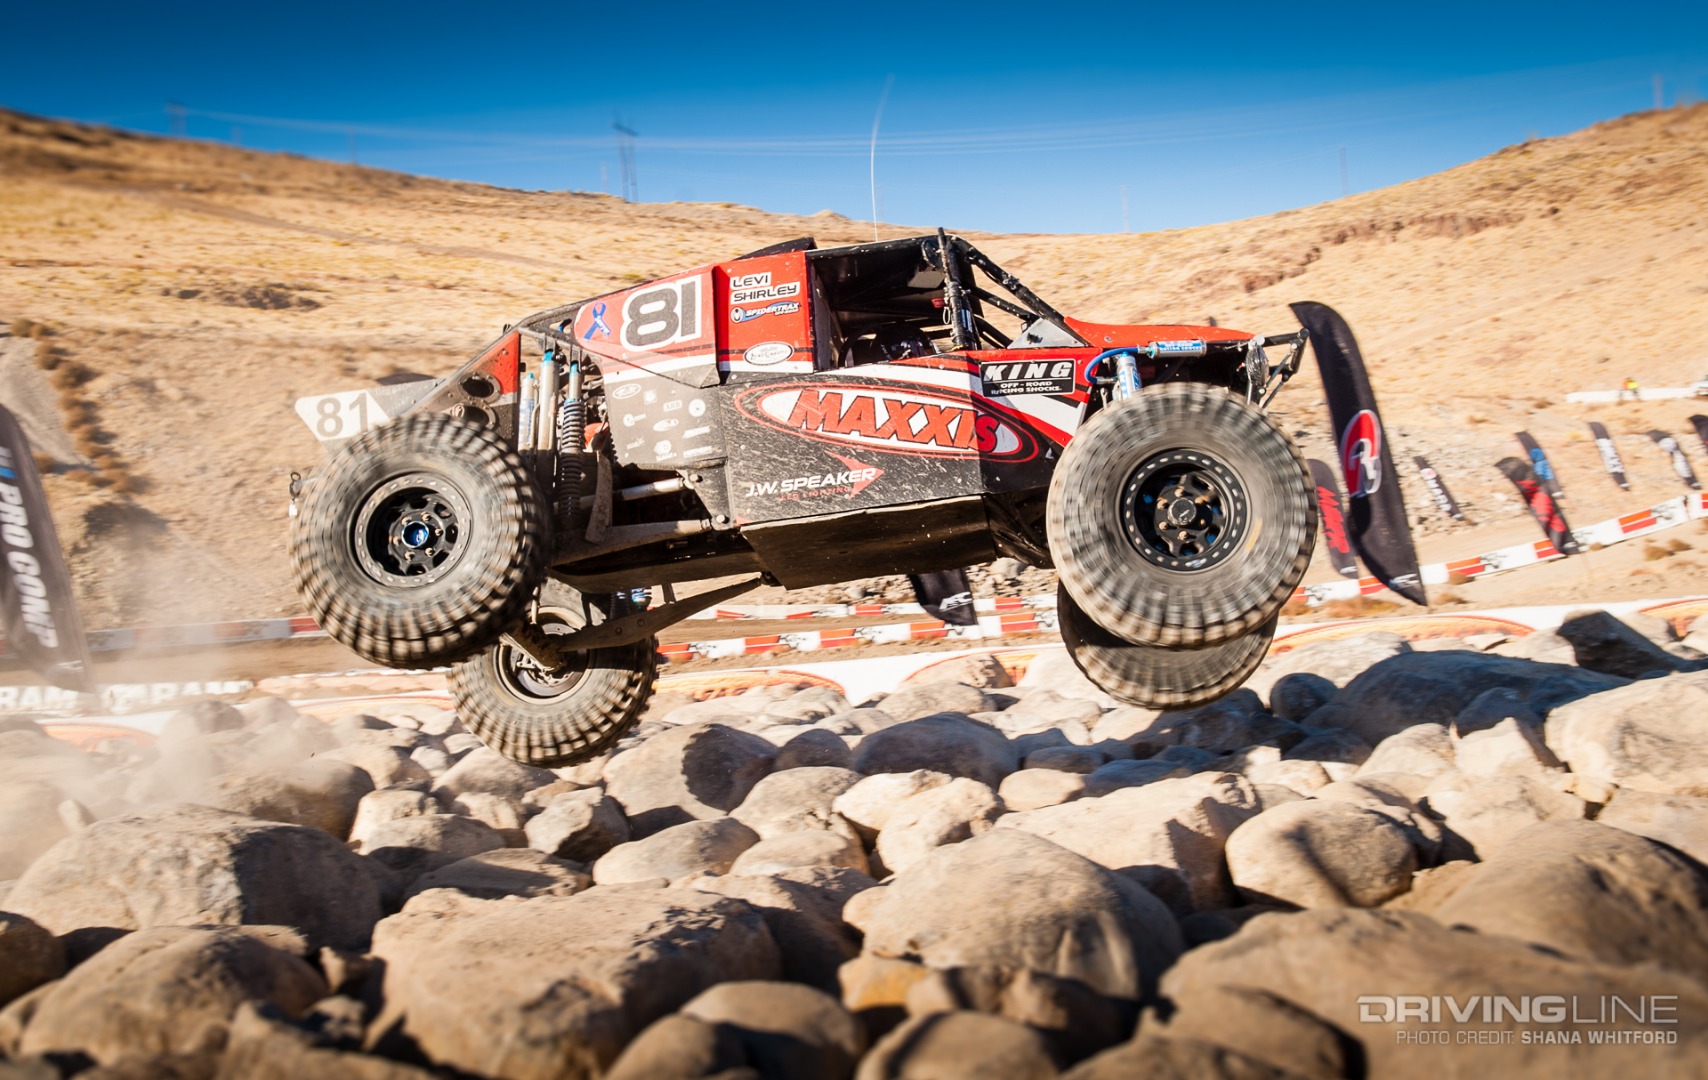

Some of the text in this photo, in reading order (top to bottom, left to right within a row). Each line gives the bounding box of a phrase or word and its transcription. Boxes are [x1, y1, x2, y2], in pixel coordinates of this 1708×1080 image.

[733, 275, 768, 288] LEVI
[734, 284, 797, 302] SHIRLEY
[622, 279, 698, 348] 81
[745, 302, 800, 317] SPIDERTRAX
[983, 361, 1073, 381] KING
[316, 392, 369, 437] 81
[786, 388, 1000, 453] MAXXIS
[780, 467, 877, 493] SPEAKER
[0, 482, 59, 647] PRO COMP
[0, 685, 79, 711] RAM
